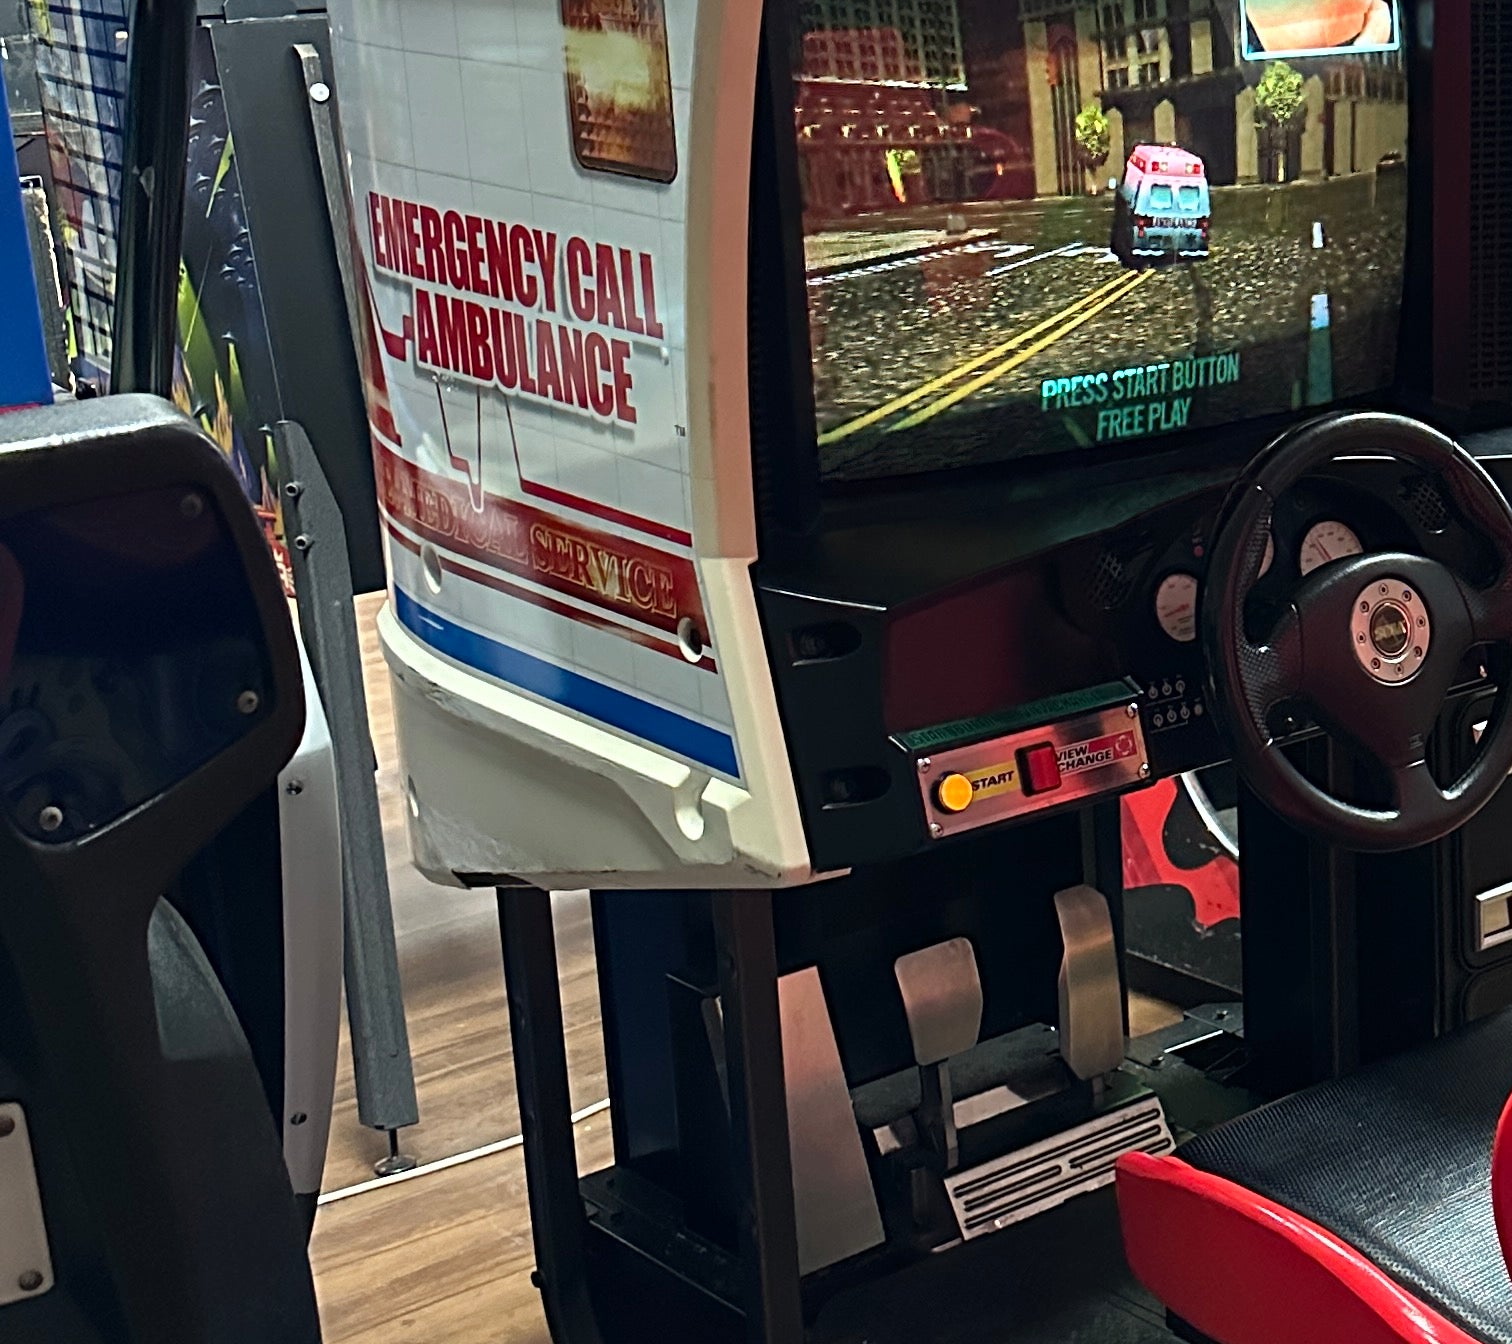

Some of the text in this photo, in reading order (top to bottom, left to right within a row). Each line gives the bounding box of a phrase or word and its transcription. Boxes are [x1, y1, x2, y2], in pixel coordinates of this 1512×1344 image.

[368, 190, 664, 340] EMERGENCY CALL
[415, 287, 638, 425] AMBULANCE
[1041, 352, 1241, 412] PRESS START BUTTON
[1096, 397, 1193, 441] FREE PLAY
[530, 523, 677, 619] SERVICE
[1056, 744, 1089, 762] VIEW
[1057, 750, 1113, 773] CHANGE
[971, 770, 1015, 791] START
